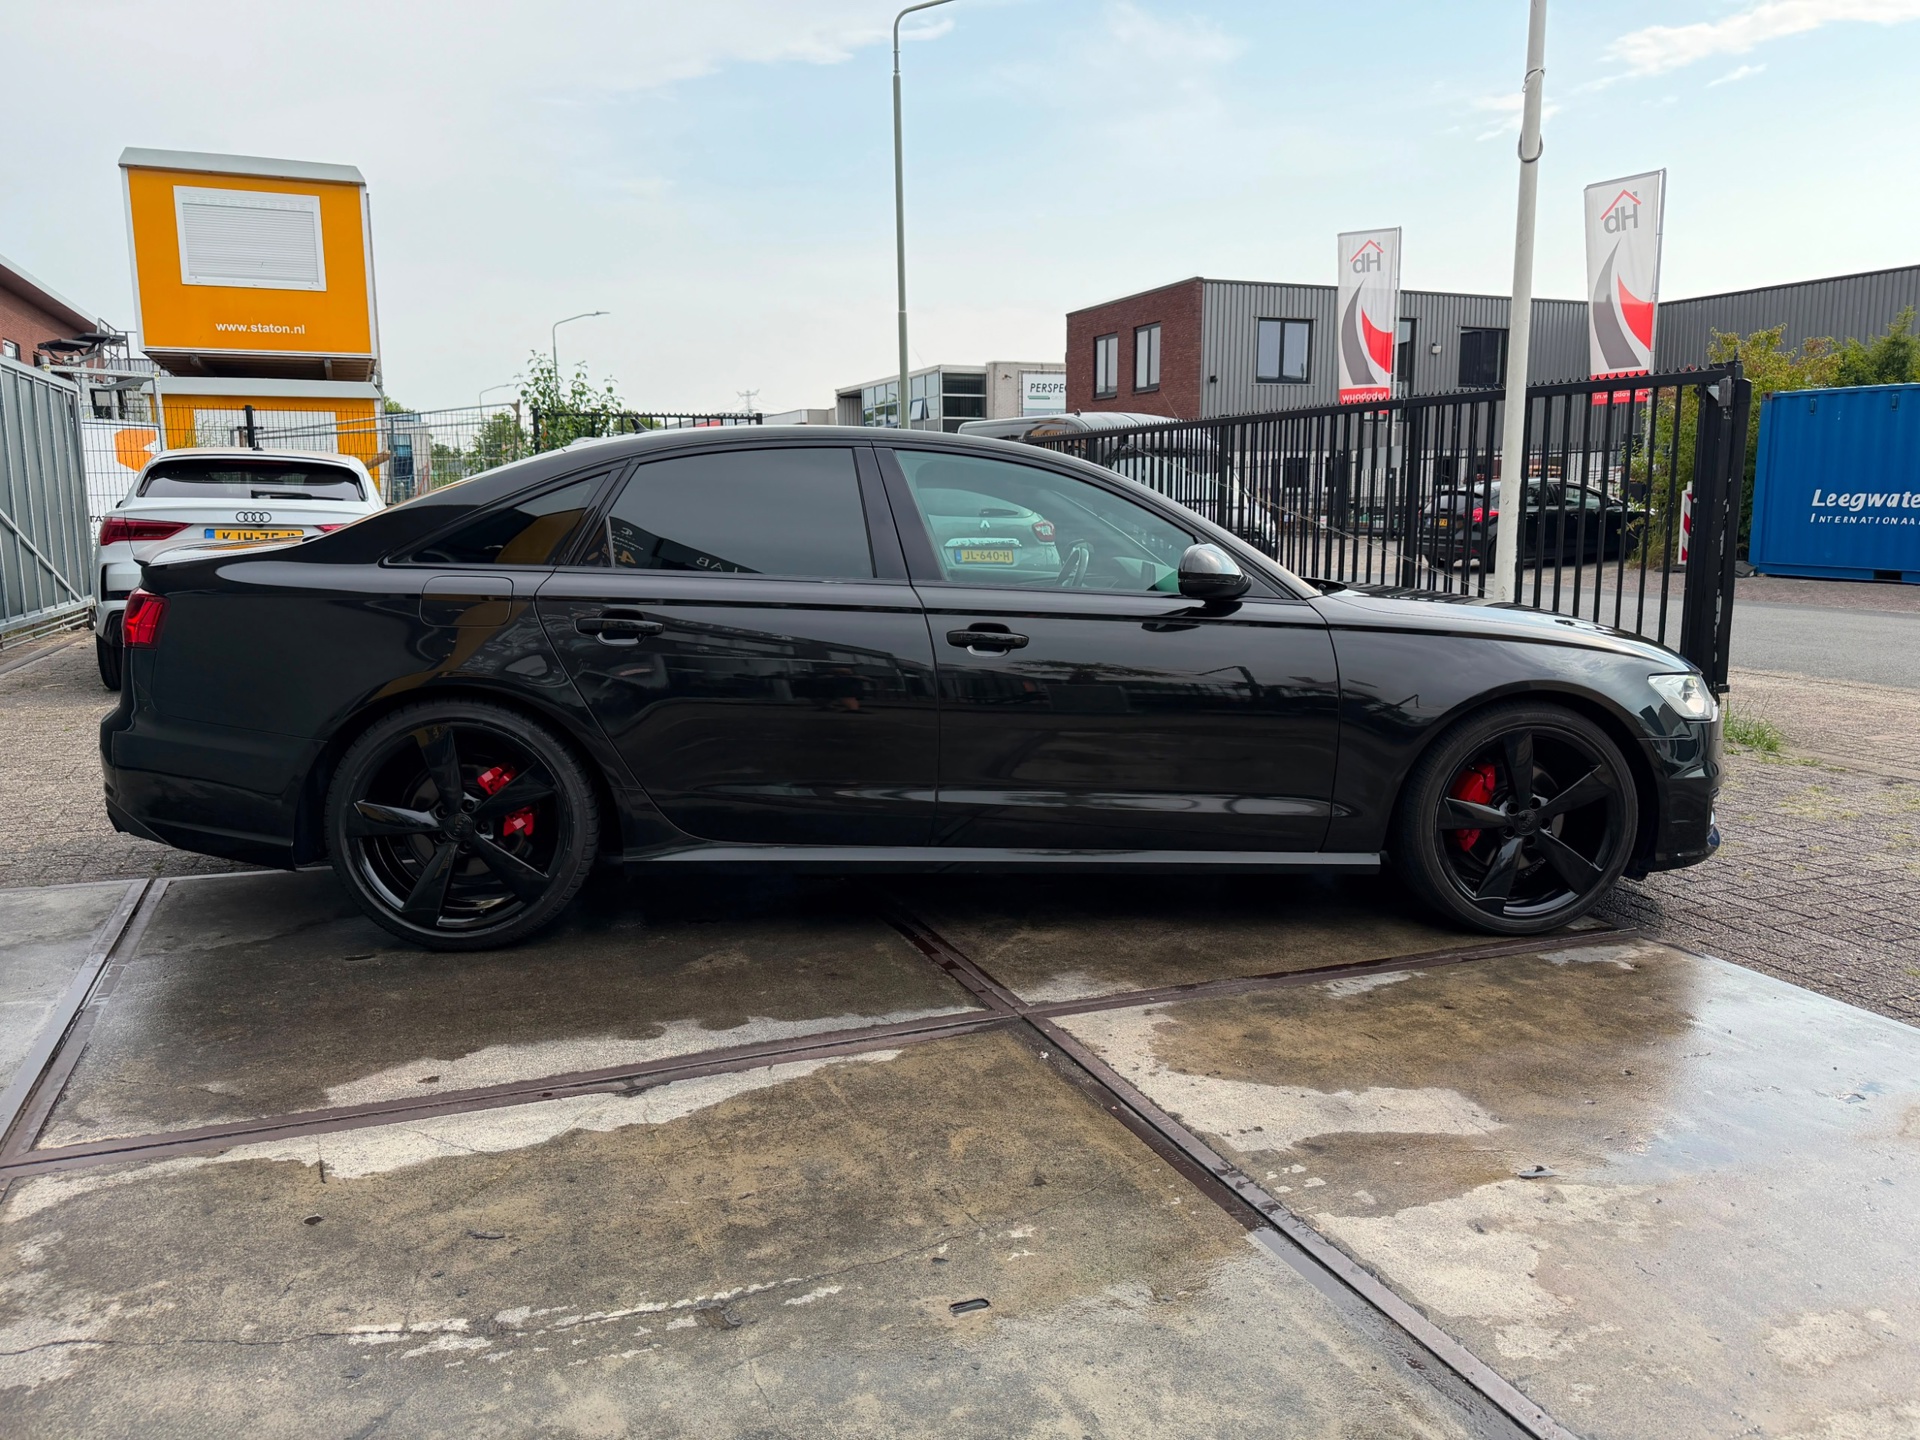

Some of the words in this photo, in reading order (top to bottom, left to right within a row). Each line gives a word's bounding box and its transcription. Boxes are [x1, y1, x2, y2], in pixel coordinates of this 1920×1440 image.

[215, 322, 305, 334] www.staton.nl
[1811, 489, 1920, 511] Leegwate
[1810, 512, 1920, 525] INTERNATIONAA
[964, 551, 1010, 561] JL-640-H
